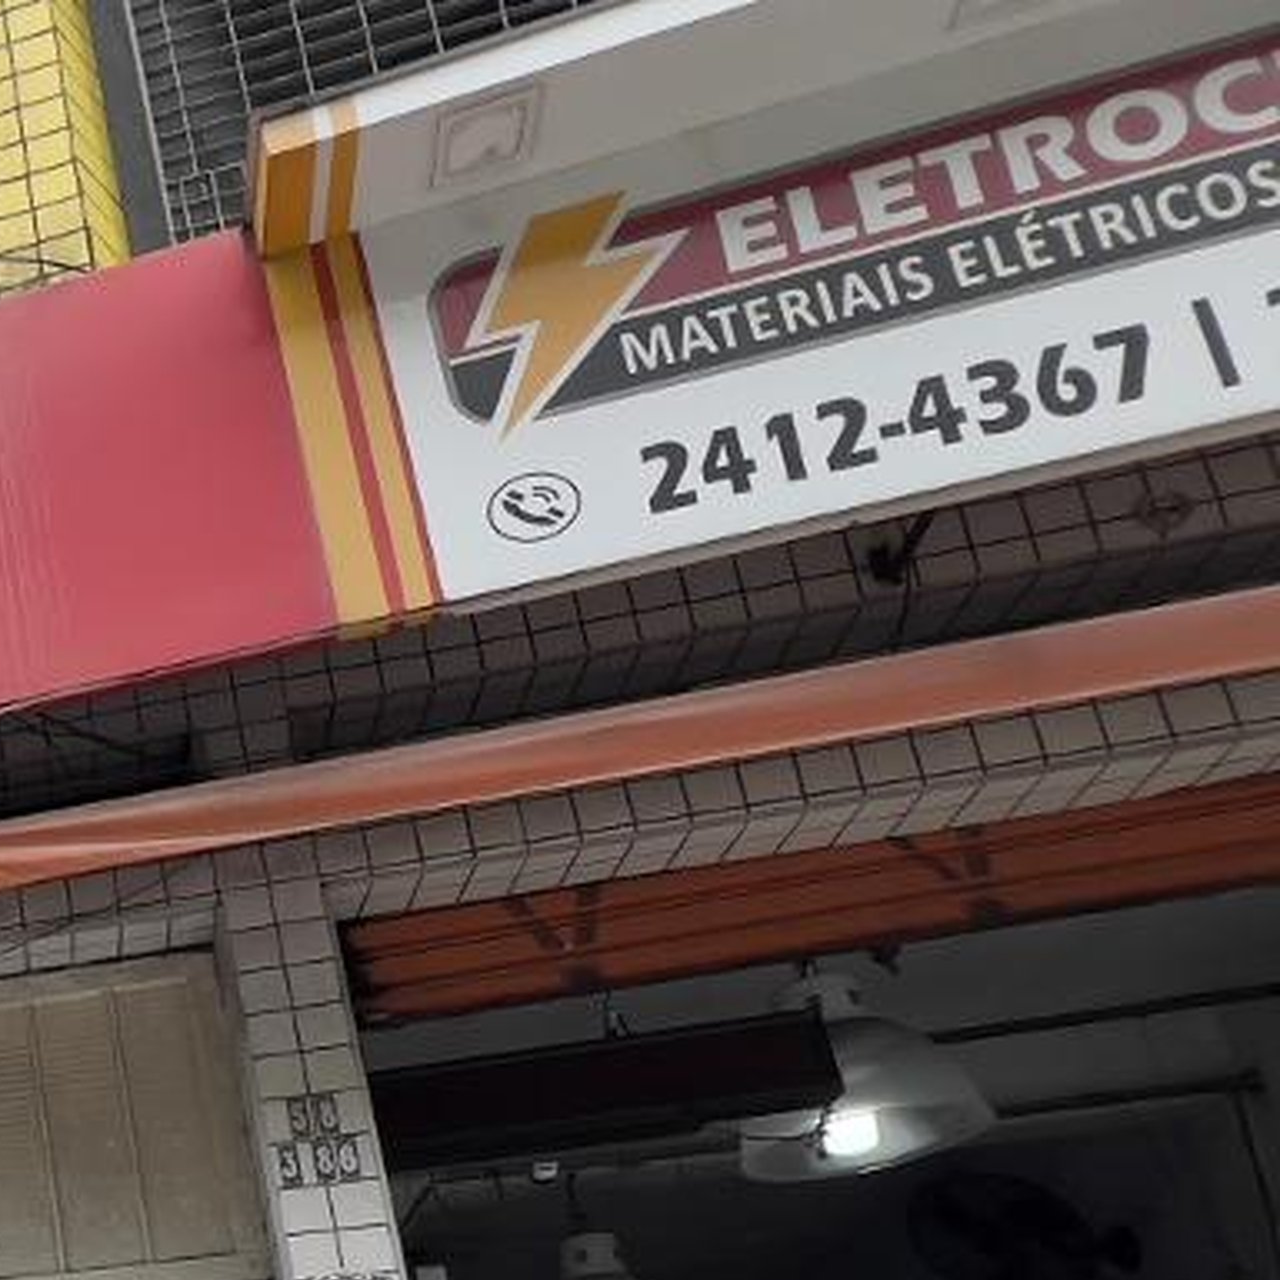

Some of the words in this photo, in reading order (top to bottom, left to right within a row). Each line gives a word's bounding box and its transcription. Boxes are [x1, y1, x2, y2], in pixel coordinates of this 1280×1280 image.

[619, 256, 934, 375] MATERIAIS
[948, 158, 1280, 290] ELÉTRICOS
[716, 50, 1280, 274] ELETROC
[640, 323, 1149, 514] 2412-4367
